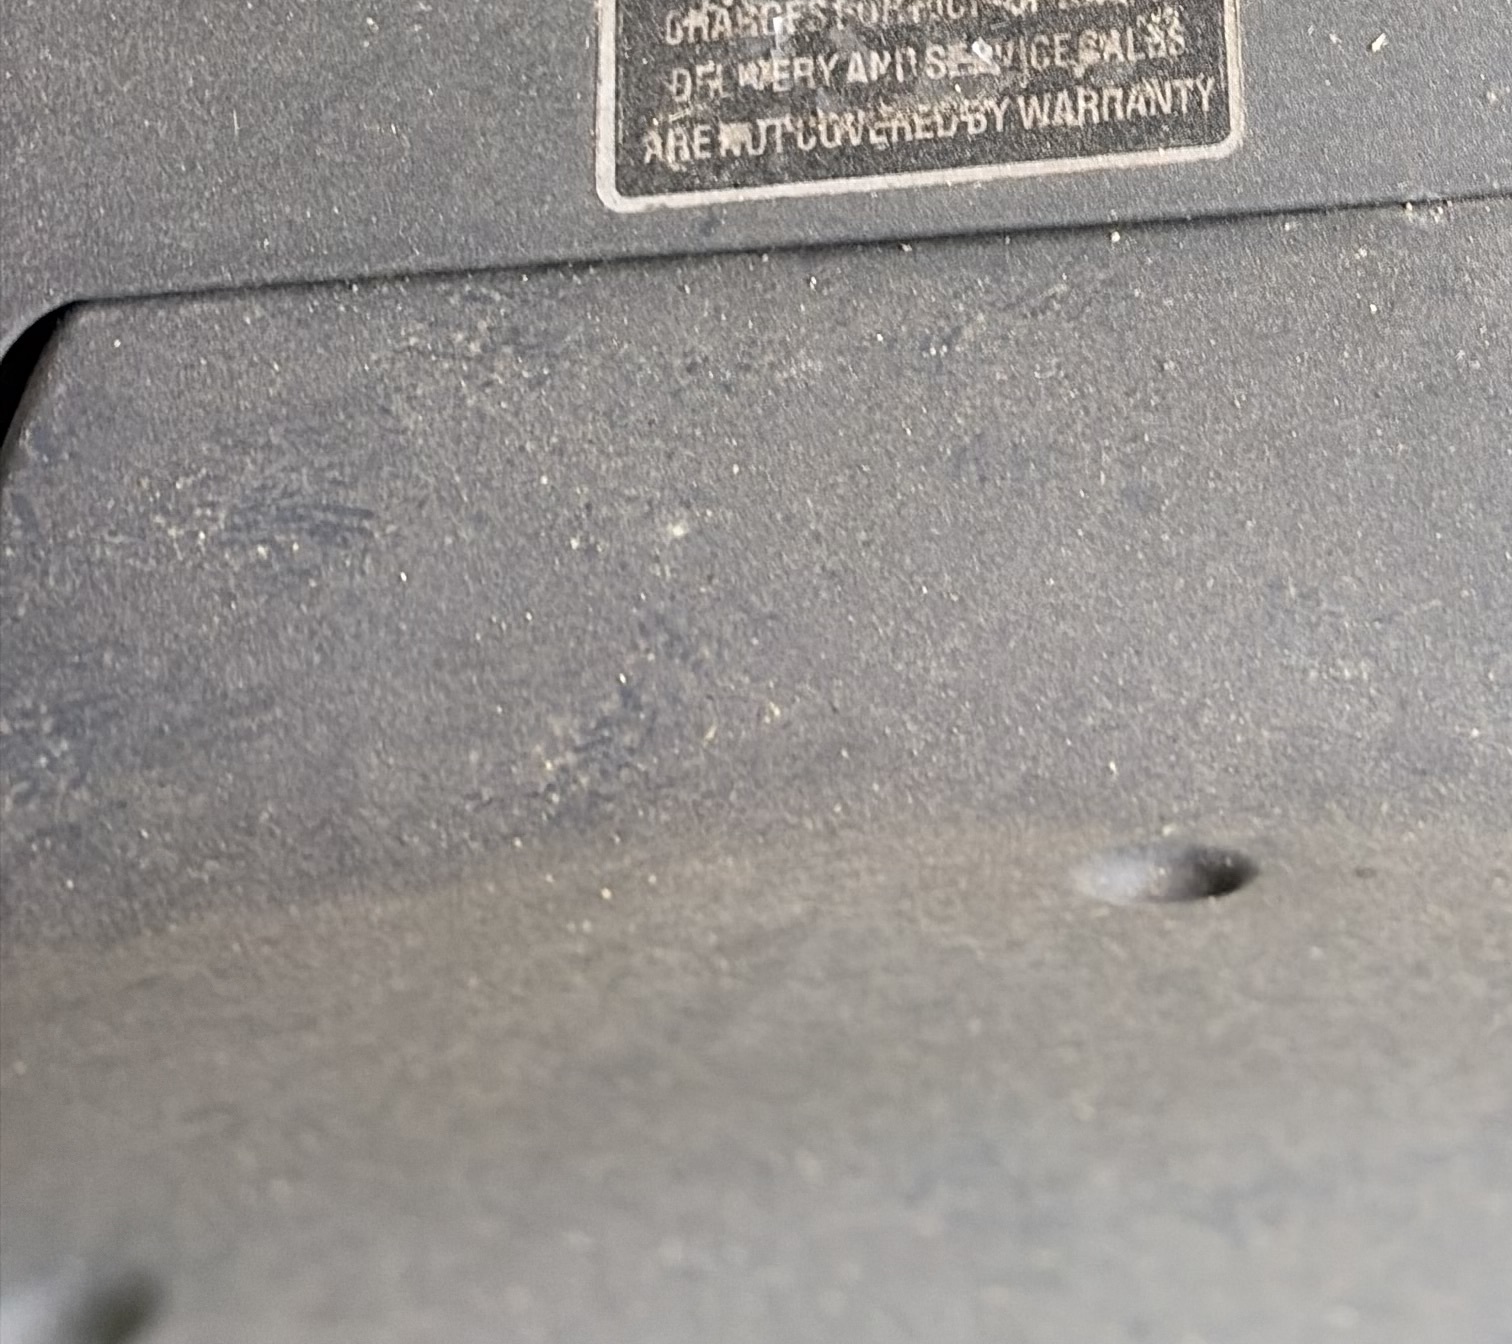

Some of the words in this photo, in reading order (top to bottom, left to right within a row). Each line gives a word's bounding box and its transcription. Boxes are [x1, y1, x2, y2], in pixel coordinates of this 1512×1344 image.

[643, 124, 712, 164] ARE
[960, 96, 1011, 136] BY
[1018, 75, 1215, 130] WARRANTY
